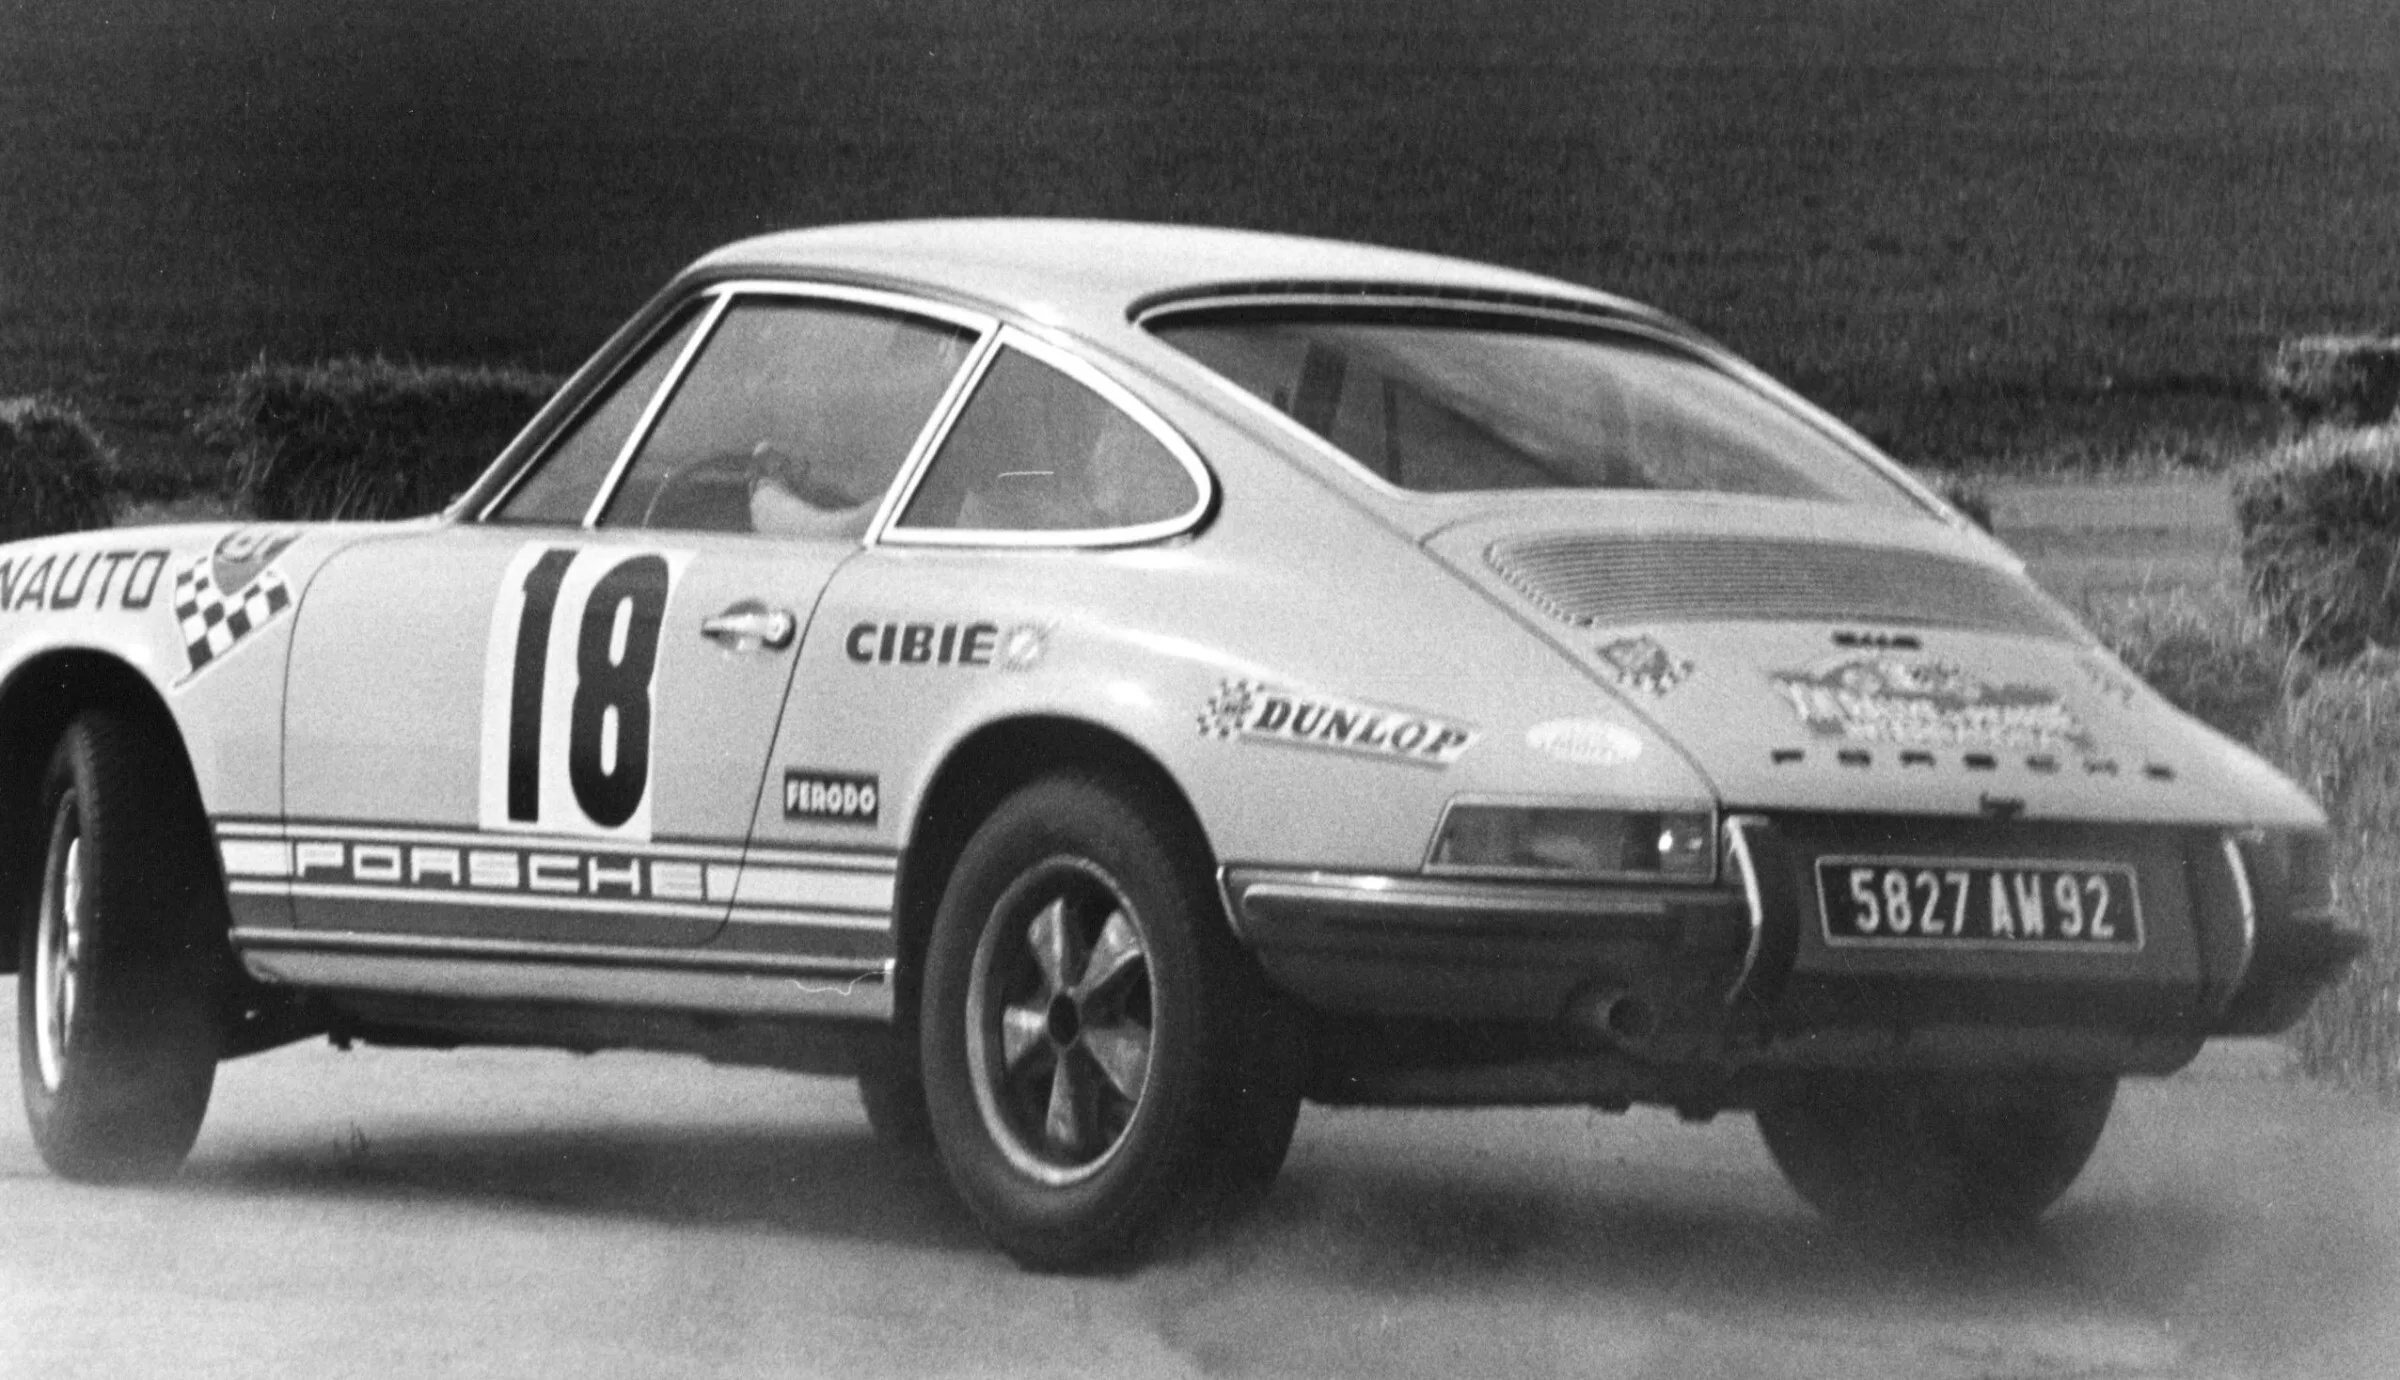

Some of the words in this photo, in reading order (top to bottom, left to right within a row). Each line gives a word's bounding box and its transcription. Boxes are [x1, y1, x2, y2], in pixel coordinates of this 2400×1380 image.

[507, 549, 669, 830] 18
[1252, 696, 1469, 756] DUNLOP
[786, 780, 876, 815] FERODO
[296, 841, 703, 898] PORSCHE
[1850, 868, 1970, 935] 5827
[1990, 872, 2045, 938] AW
[2054, 874, 2114, 940] 92
